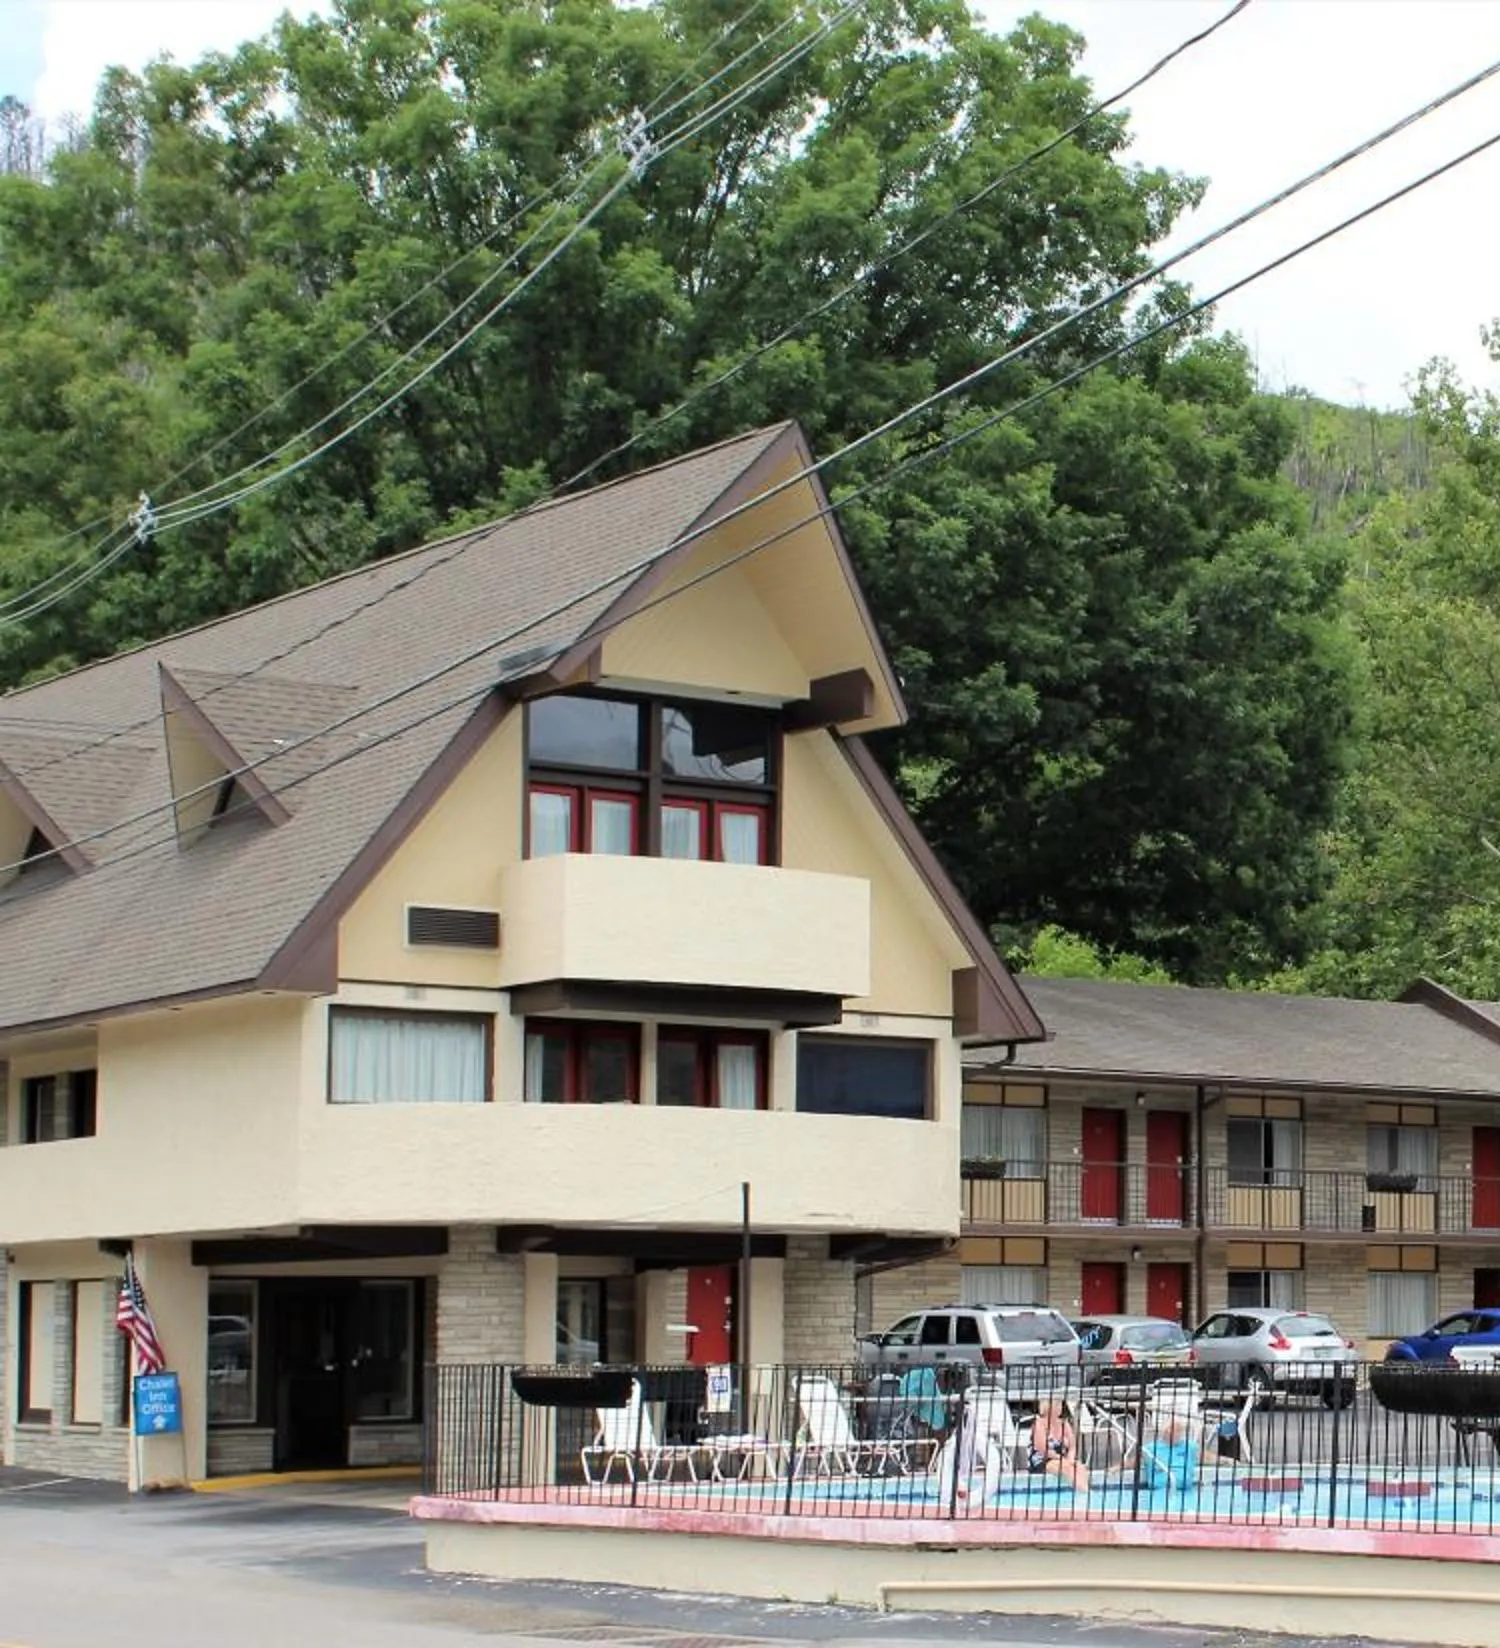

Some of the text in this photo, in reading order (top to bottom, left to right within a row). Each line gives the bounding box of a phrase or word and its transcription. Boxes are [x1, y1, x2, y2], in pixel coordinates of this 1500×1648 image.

[139, 1379, 174, 1390] Chalet
[148, 1391, 167, 1402] Inn
[142, 1403, 175, 1415] Office
